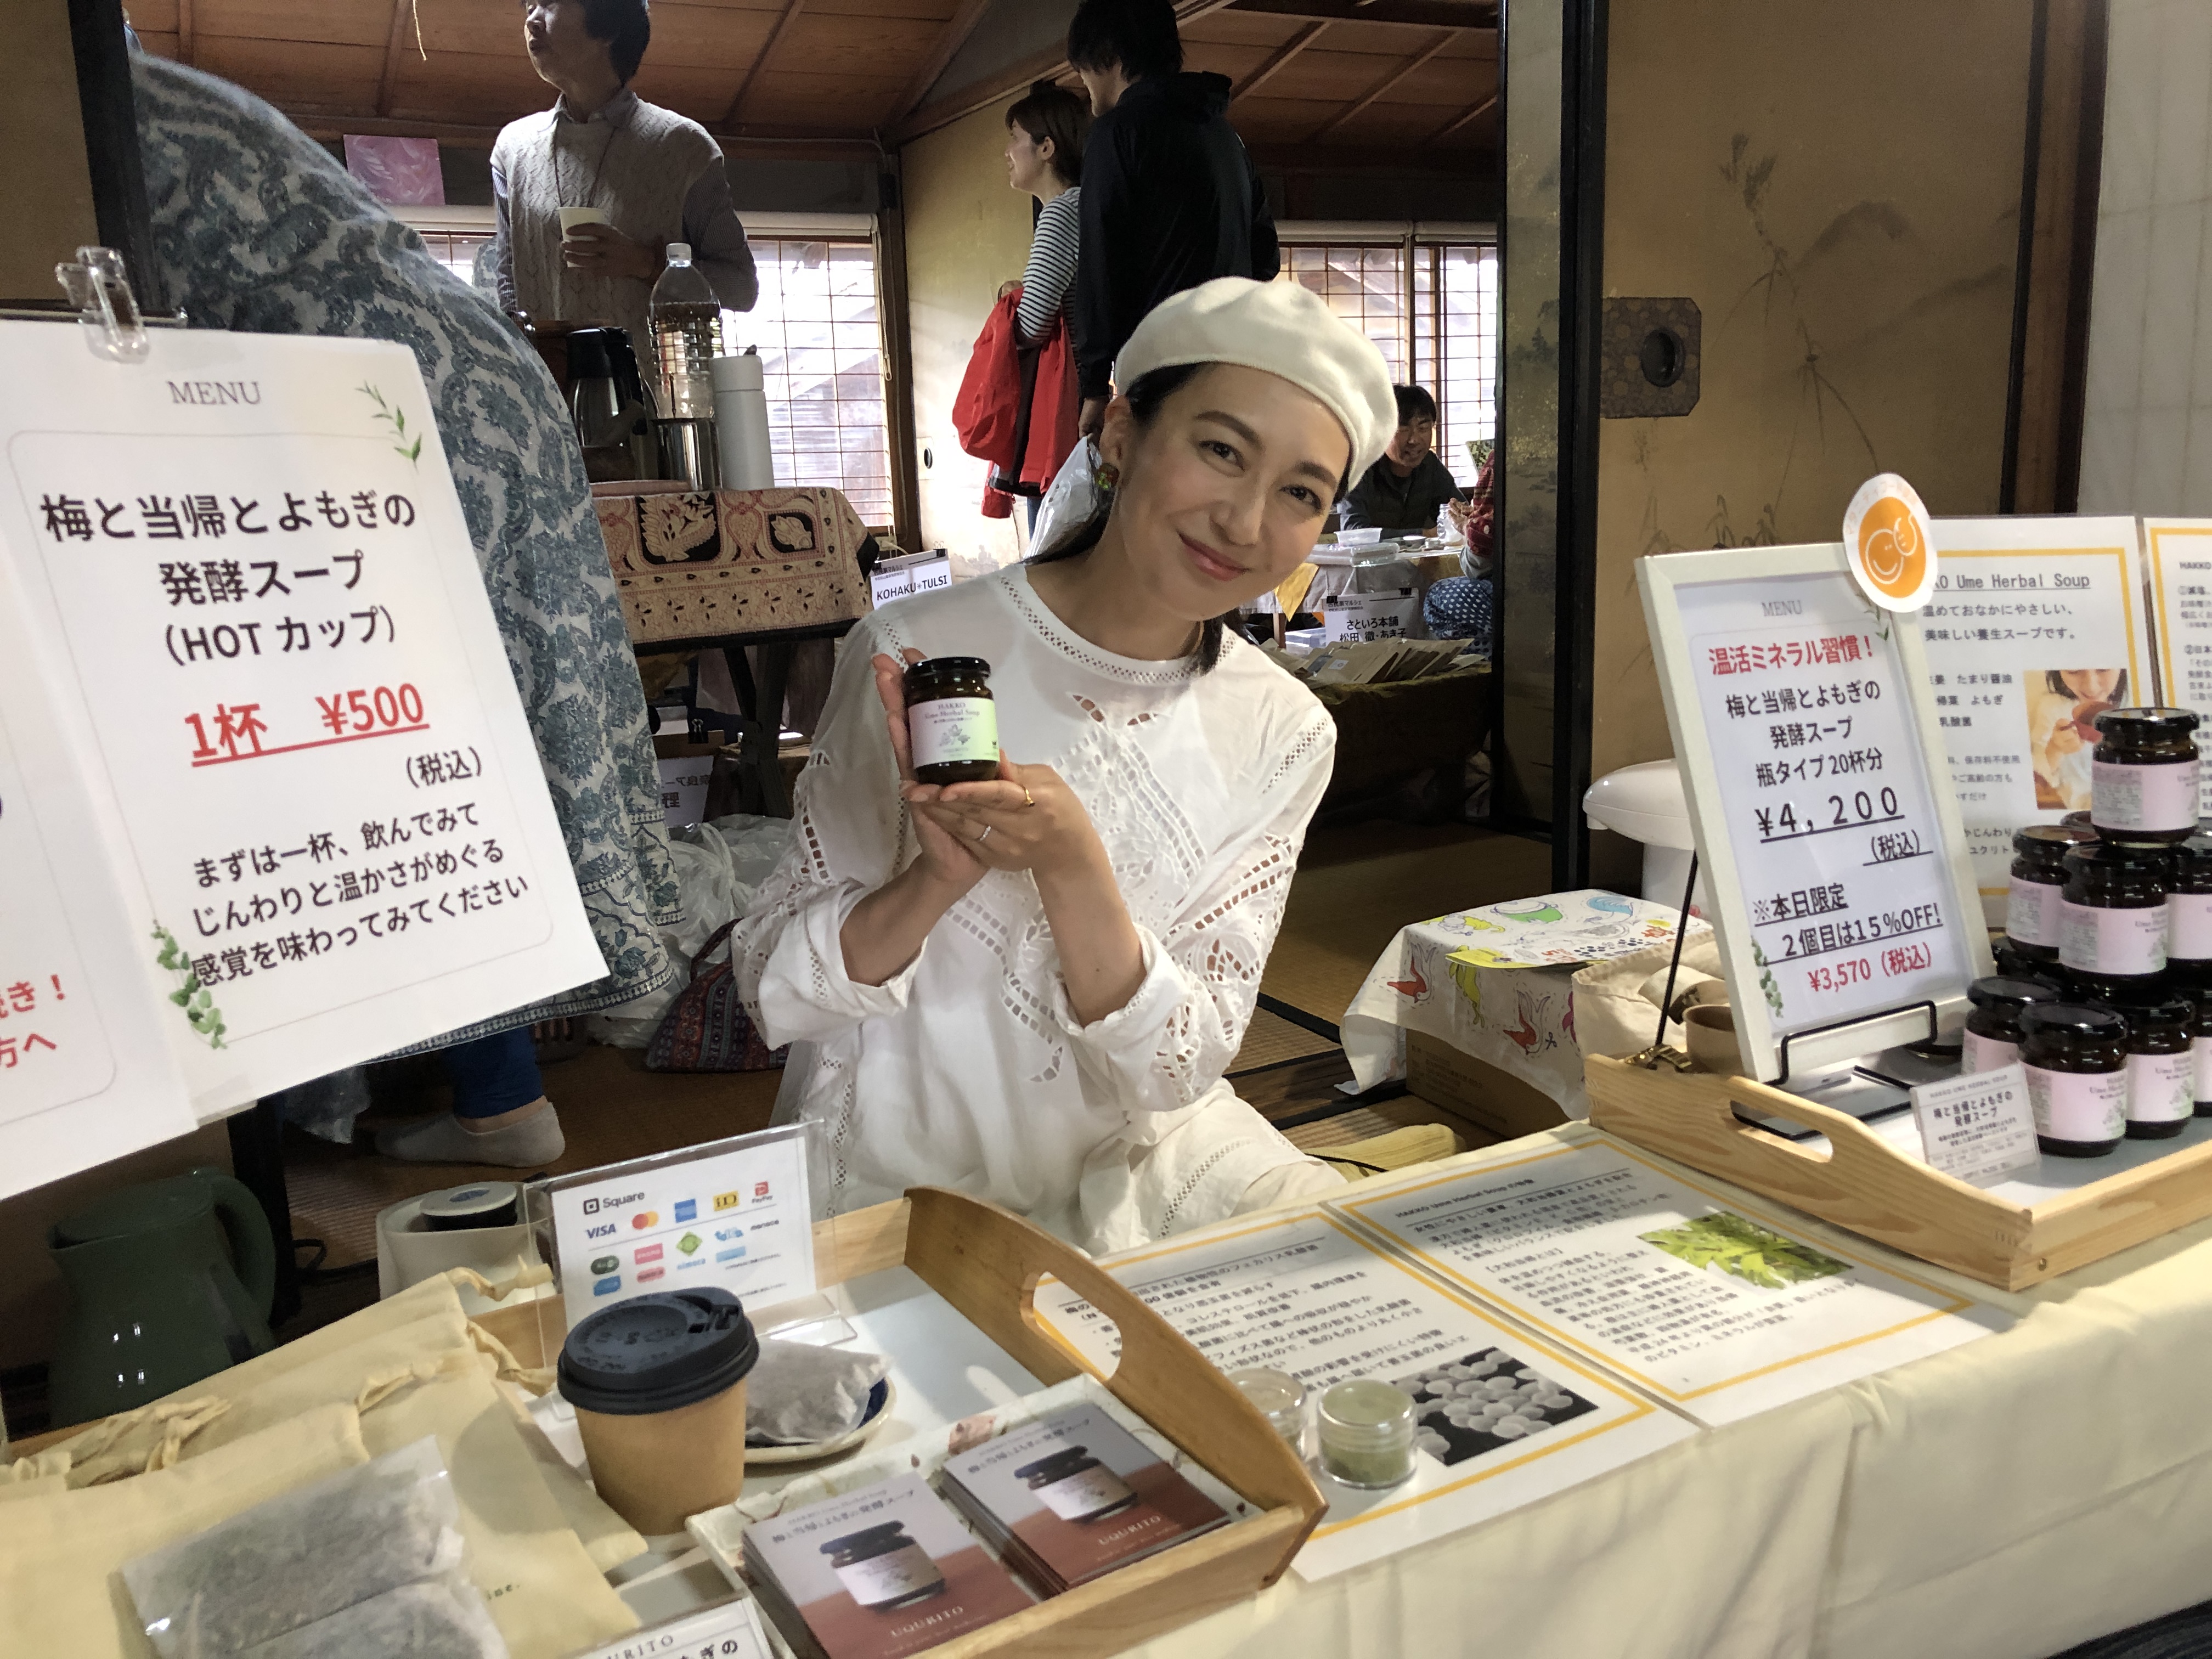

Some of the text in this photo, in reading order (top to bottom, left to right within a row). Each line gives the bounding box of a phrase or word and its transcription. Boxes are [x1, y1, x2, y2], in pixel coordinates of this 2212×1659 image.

[167, 381, 262, 406] MENU
[41, 492, 416, 543] 梅と当帰とよもぎの
[159, 550, 364, 606] 発酵スープ
[1957, 574, 1984, 589] Ume
[1992, 574, 2044, 588] Herbal
[2054, 573, 2091, 588] Soup
[1347, 616, 1398, 630] さといろ本舗
[1761, 600, 1802, 617] MENU
[1339, 633, 1359, 642] 松田
[1708, 635, 1873, 675] 温活ミネラル習慣！
[1726, 679, 1880, 719] 梅と当帰とよもぎの
[184, 682, 425, 760] 1杯 ¥500
[1770, 715, 1853, 749] 発酵スープ
[1757, 747, 1883, 787] 瓶タイプ20杯分
[193, 802, 479, 889] まずは一杯、飲んでみて
[193, 838, 505, 939] じんわりと温かさがめぐる
[190, 874, 530, 988] 感覚を味わってみてください
[1808, 958, 1871, 992] ¥3,570
[603, 1192, 645, 1209] Square
[586, 1223, 617, 1239] VISA
